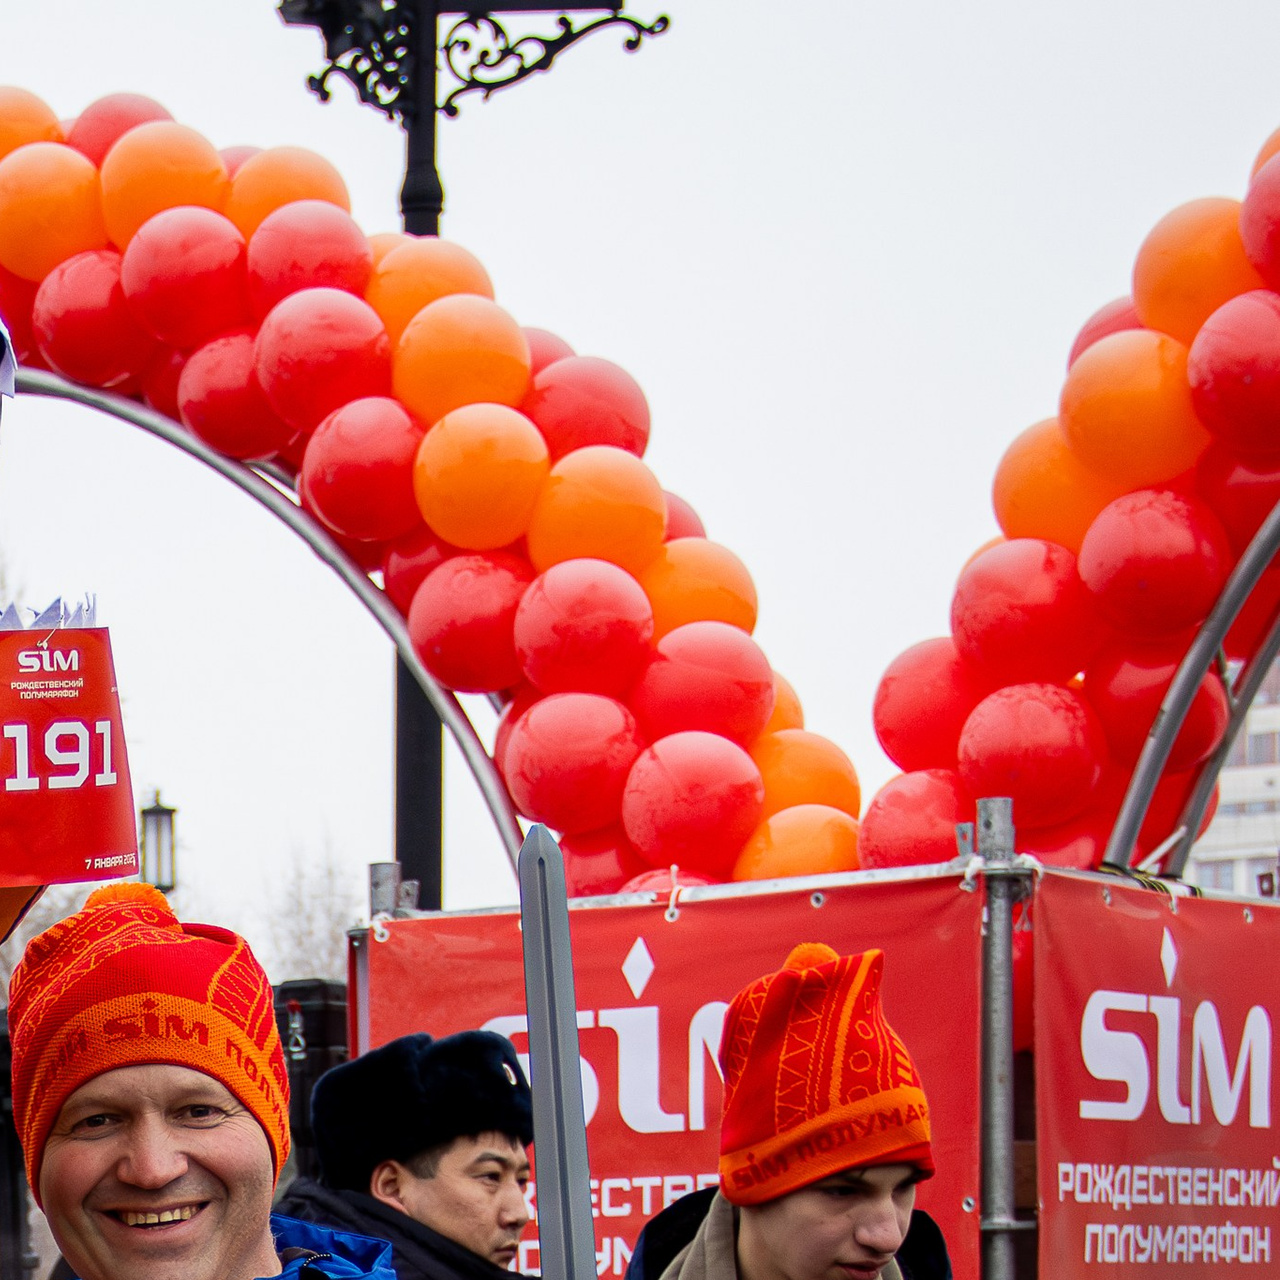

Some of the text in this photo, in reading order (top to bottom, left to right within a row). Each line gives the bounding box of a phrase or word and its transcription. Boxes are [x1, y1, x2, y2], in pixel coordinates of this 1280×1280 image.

[10, 678, 84, 690] РОЖДЕСТВЕНСКИЙ
[20, 690, 79, 700] ПОЛУМАРАФОН
[85, 858, 92, 870] 7
[94, 855, 124, 869] ЯНВАРЯ
[1084, 1220, 1272, 1264] ПОЛУМАРАФОН
